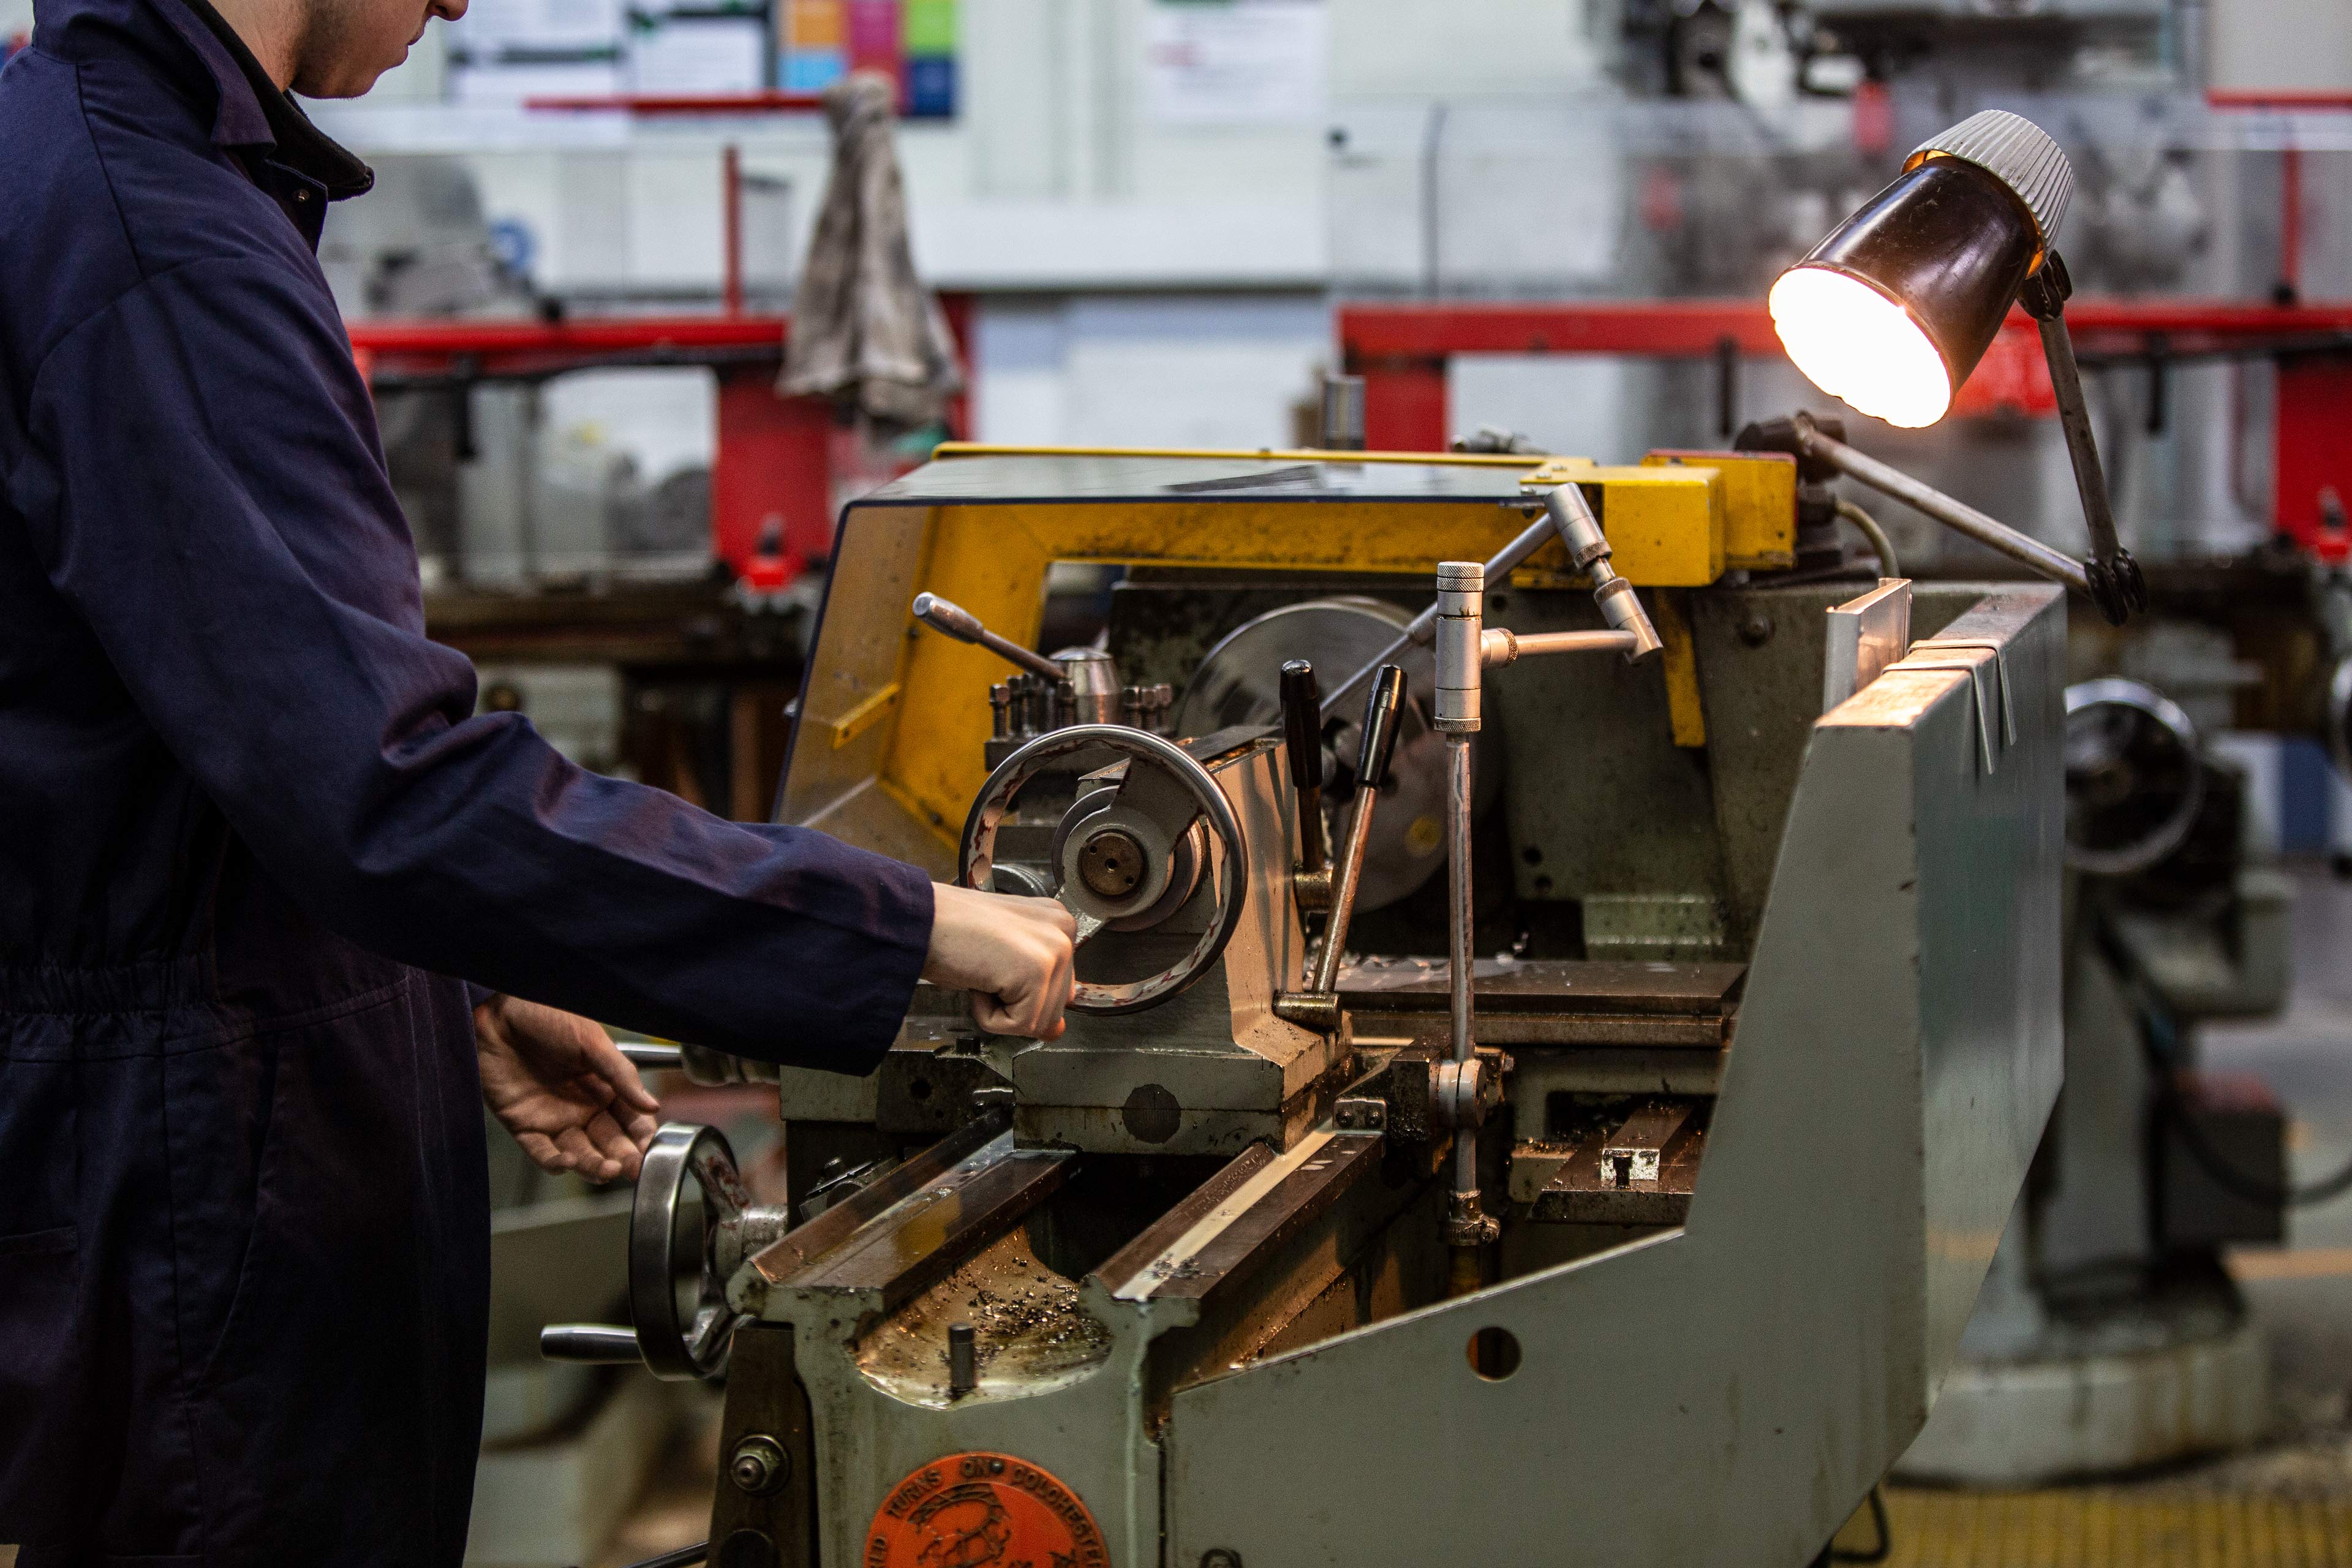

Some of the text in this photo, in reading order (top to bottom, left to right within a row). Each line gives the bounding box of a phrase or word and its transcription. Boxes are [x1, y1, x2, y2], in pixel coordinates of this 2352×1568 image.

[886, 1469, 943, 1518] TURNS
[960, 1458, 991, 1479] ON
[1011, 1463, 1102, 1568] COLCHESTE
